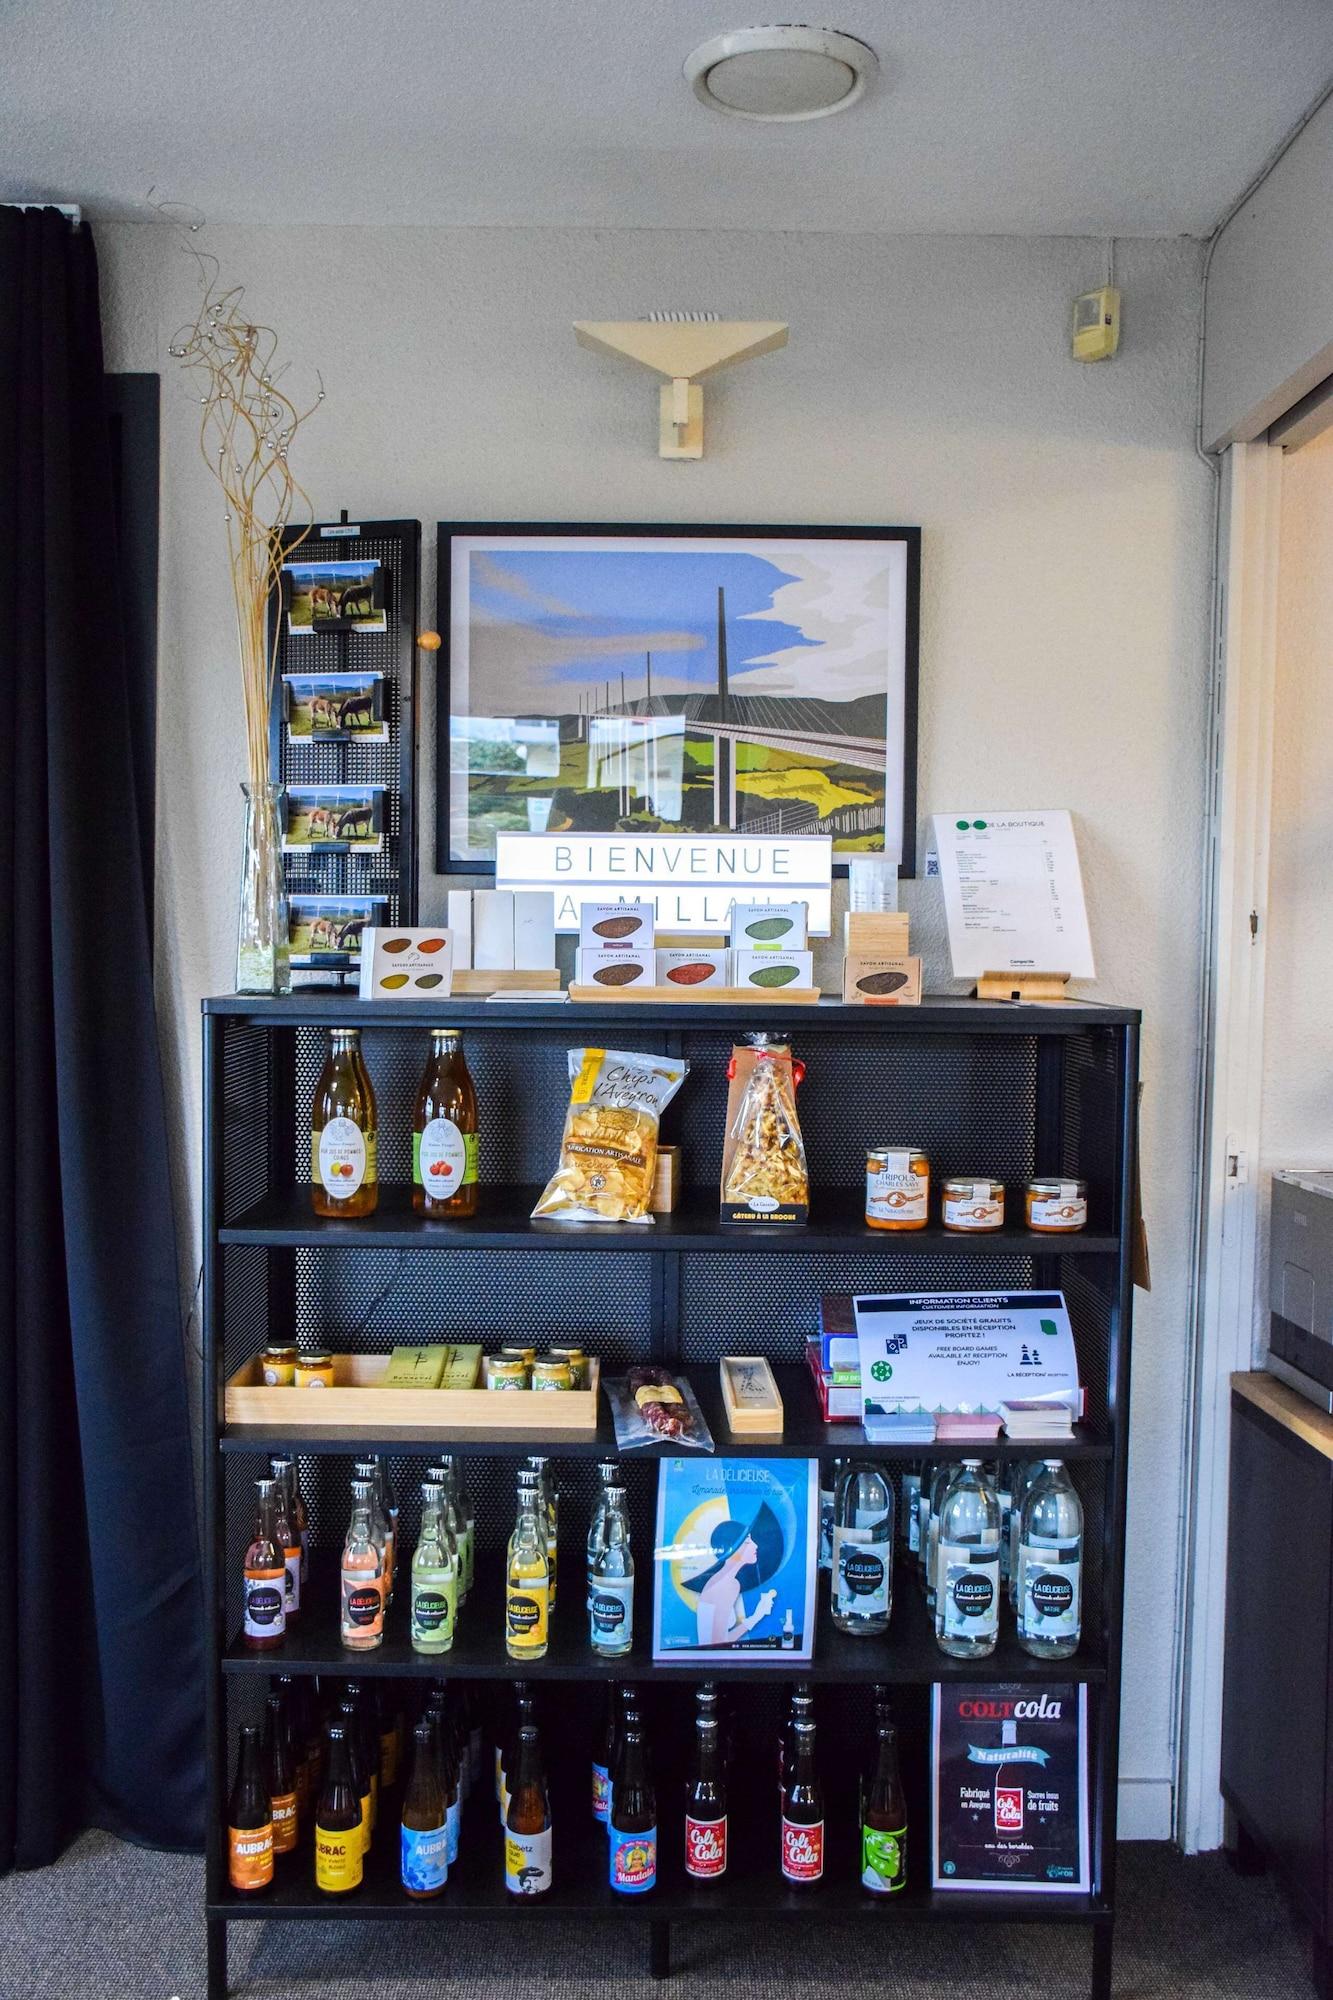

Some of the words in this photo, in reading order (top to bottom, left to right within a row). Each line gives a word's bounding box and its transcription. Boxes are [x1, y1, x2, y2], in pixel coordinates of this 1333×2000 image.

[1007, 820, 1045, 828] BOUTIQUE
[555, 846, 791, 874] BIENVENUE
[607, 1066, 657, 1087] Chips
[881, 1173, 916, 1181] TRIPOUS
[973, 1323, 1016, 1331] RÉCEPTION
[705, 1468, 719, 1481] LA
[720, 1467, 770, 1483] DÉLICIEUSE
[955, 1584, 964, 1592] LA
[964, 1583, 992, 1593] DÉLICIEUSE
[1034, 1583, 1042, 1592] LA
[1042, 1583, 1071, 1593] DÉLICIEUSE
[959, 1701, 1014, 1719] COLT
[1014, 1694, 1062, 1719] cola
[977, 1749, 1038, 1762] Naturalité
[960, 1786, 991, 1801] Fabriqué
[969, 1801, 991, 1810] Aveyron
[997, 1797, 1014, 1809] Colt
[1027, 1801, 1037, 1811] de
[1038, 1801, 1060, 1811] fruits
[272, 1804, 296, 1821] BRAC
[1001, 1807, 1021, 1819] Cola
[690, 1829, 715, 1845] Colt
[786, 1831, 809, 1848] Colt
[694, 1844, 723, 1860] Cola
[790, 1847, 819, 1864] Cola
[617, 1865, 655, 1884] Mandala
